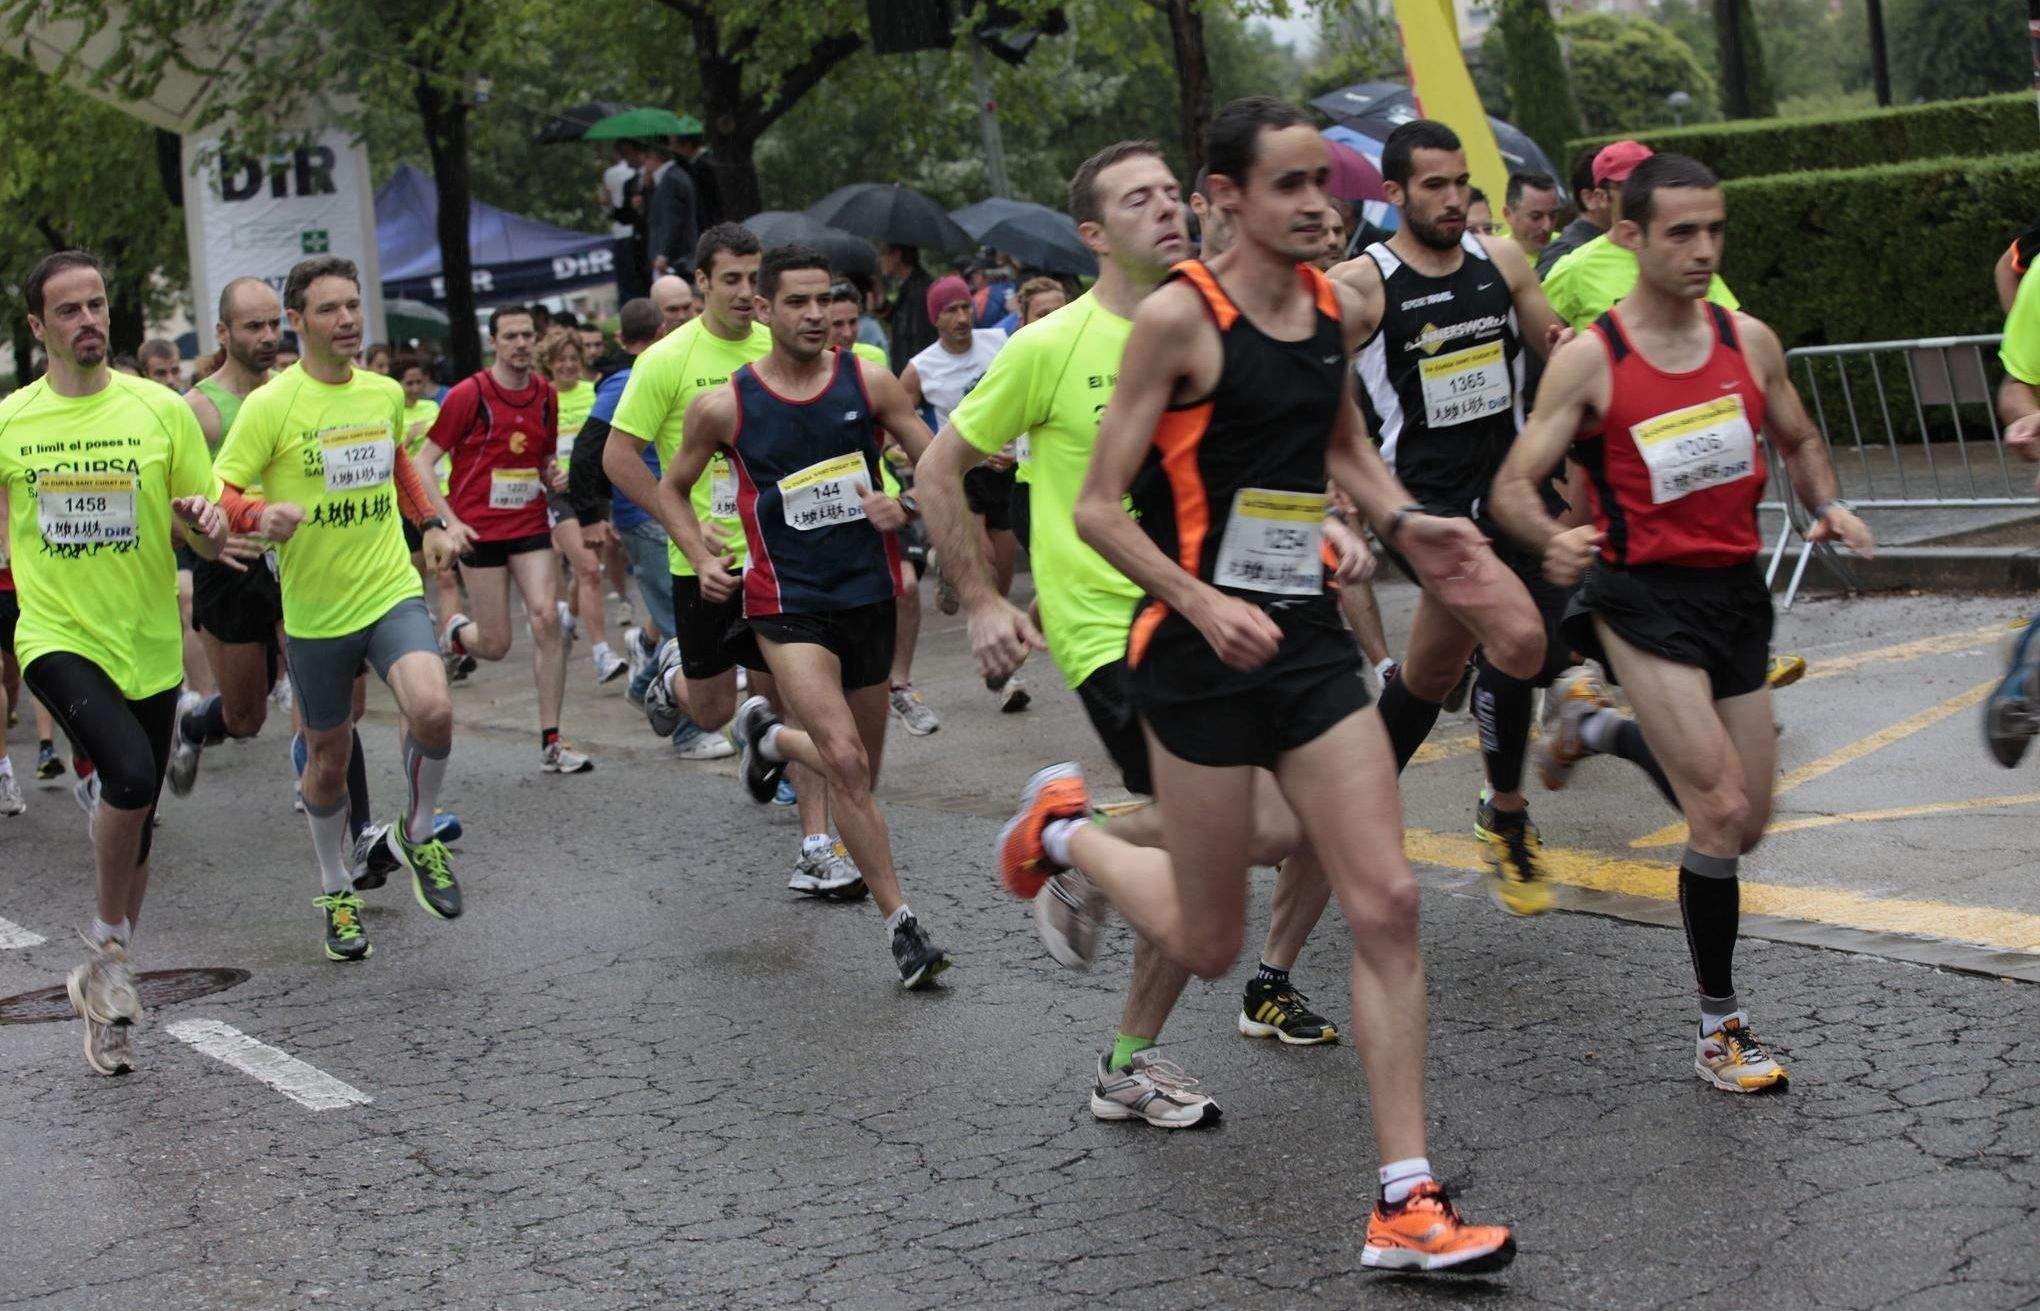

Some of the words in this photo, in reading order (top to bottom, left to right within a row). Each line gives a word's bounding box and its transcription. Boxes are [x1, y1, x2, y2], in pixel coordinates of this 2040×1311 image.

[431, 270, 494, 299] DR
[1449, 371, 1487, 394] 1365
[20, 446, 32, 457] El
[37, 442, 65, 453] limit
[70, 441, 81, 450] el
[86, 439, 123, 450] poses
[128, 437, 141, 446] tu
[344, 445, 376, 462] 1222
[812, 482, 841, 500] 144
[65, 497, 107, 513] 1458
[847, 506, 864, 518] Di
